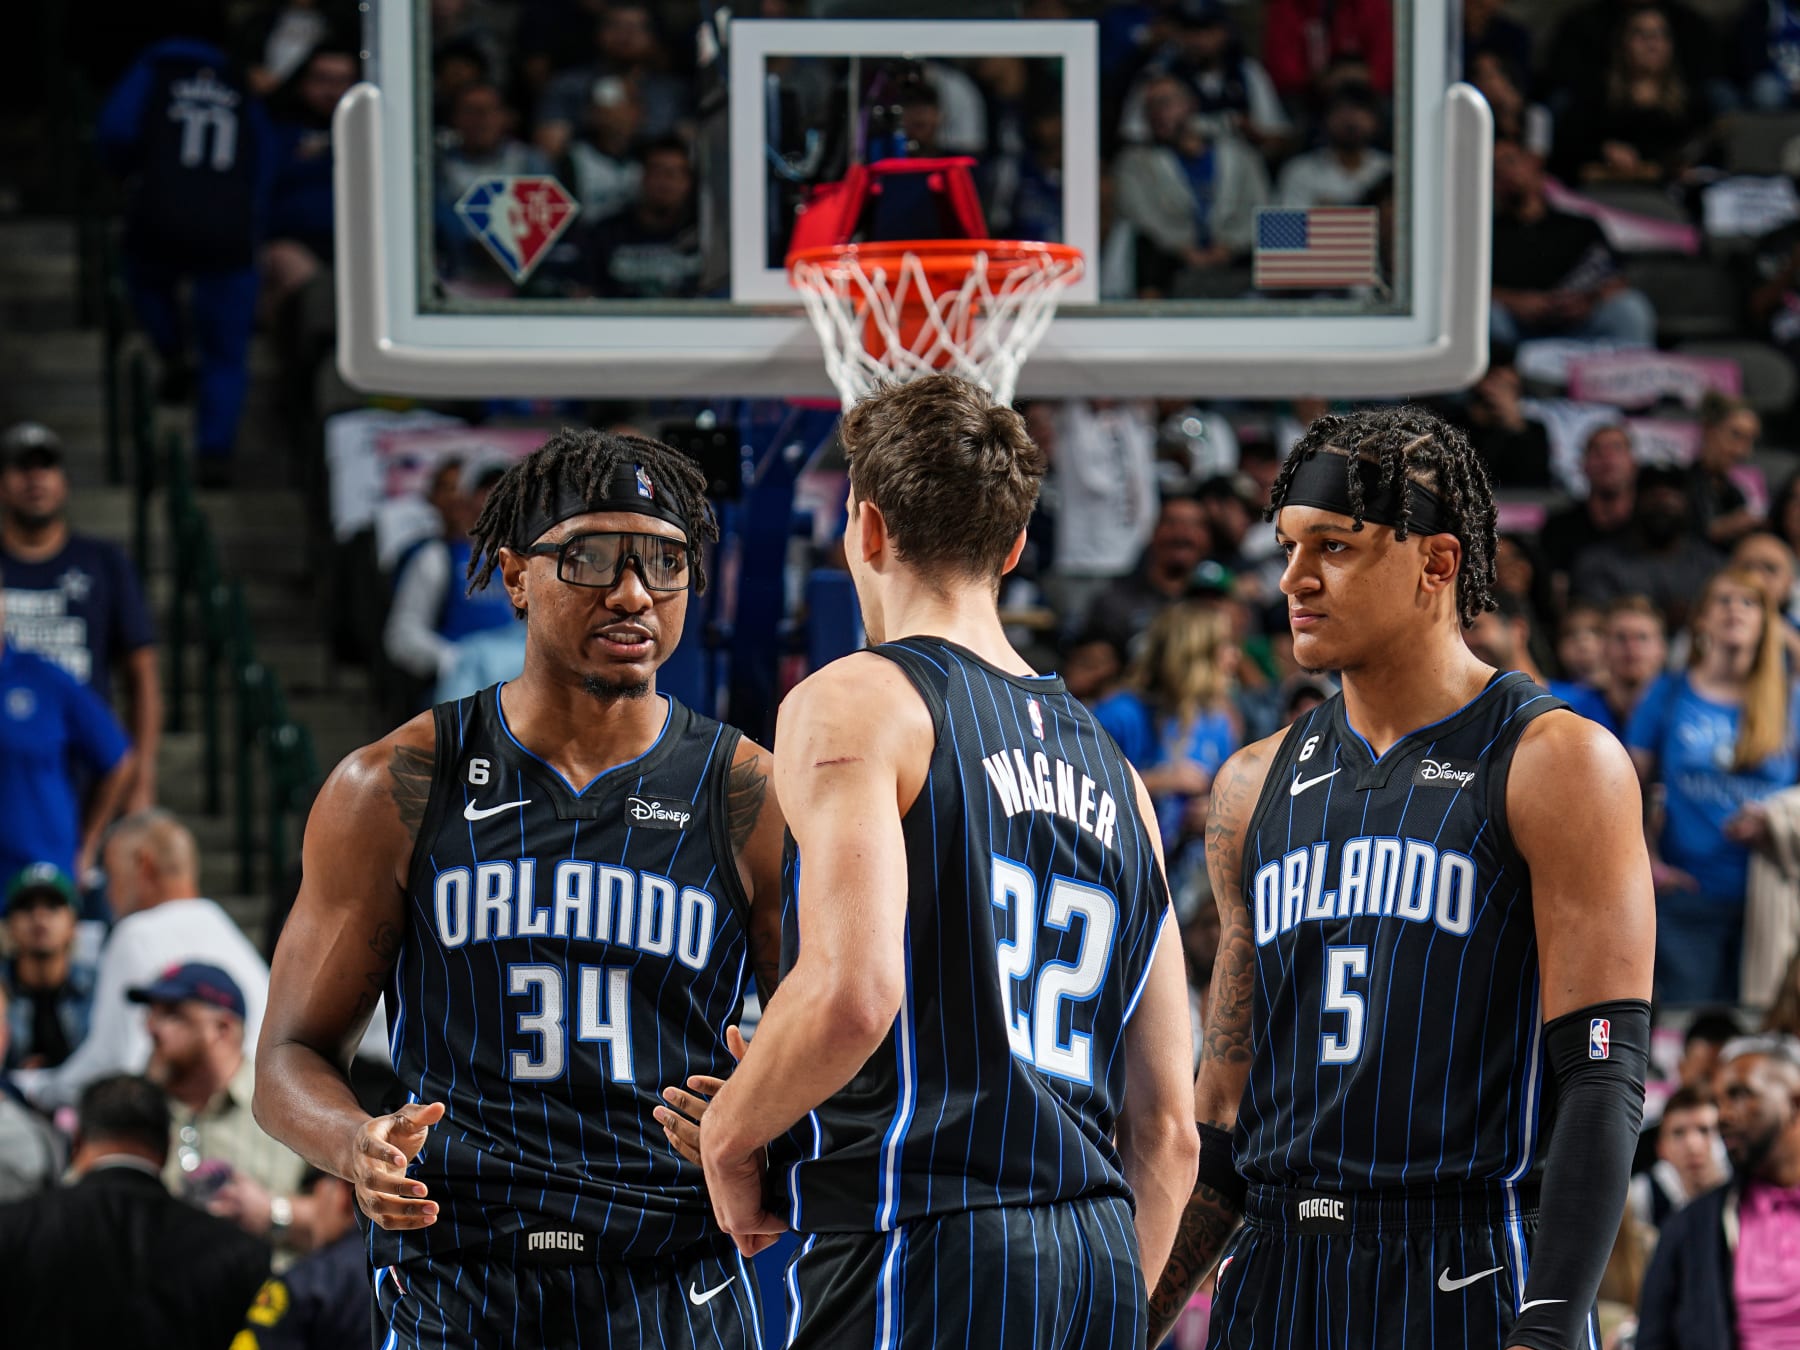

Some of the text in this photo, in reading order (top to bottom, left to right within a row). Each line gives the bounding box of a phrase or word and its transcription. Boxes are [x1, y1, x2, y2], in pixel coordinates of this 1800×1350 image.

[167, 103, 239, 171] 77
[467, 758, 491, 785] 6
[982, 748, 1116, 849] WAGNER
[1299, 735, 1320, 762] 6
[434, 857, 717, 972] ORLANDO
[1254, 835, 1478, 947] ORLANDO
[991, 852, 1120, 1087] 22
[1320, 944, 1369, 1065] 5
[507, 962, 636, 1083] 34
[528, 1231, 585, 1252] MAGIC
[1298, 1198, 1345, 1222] MAGIC
